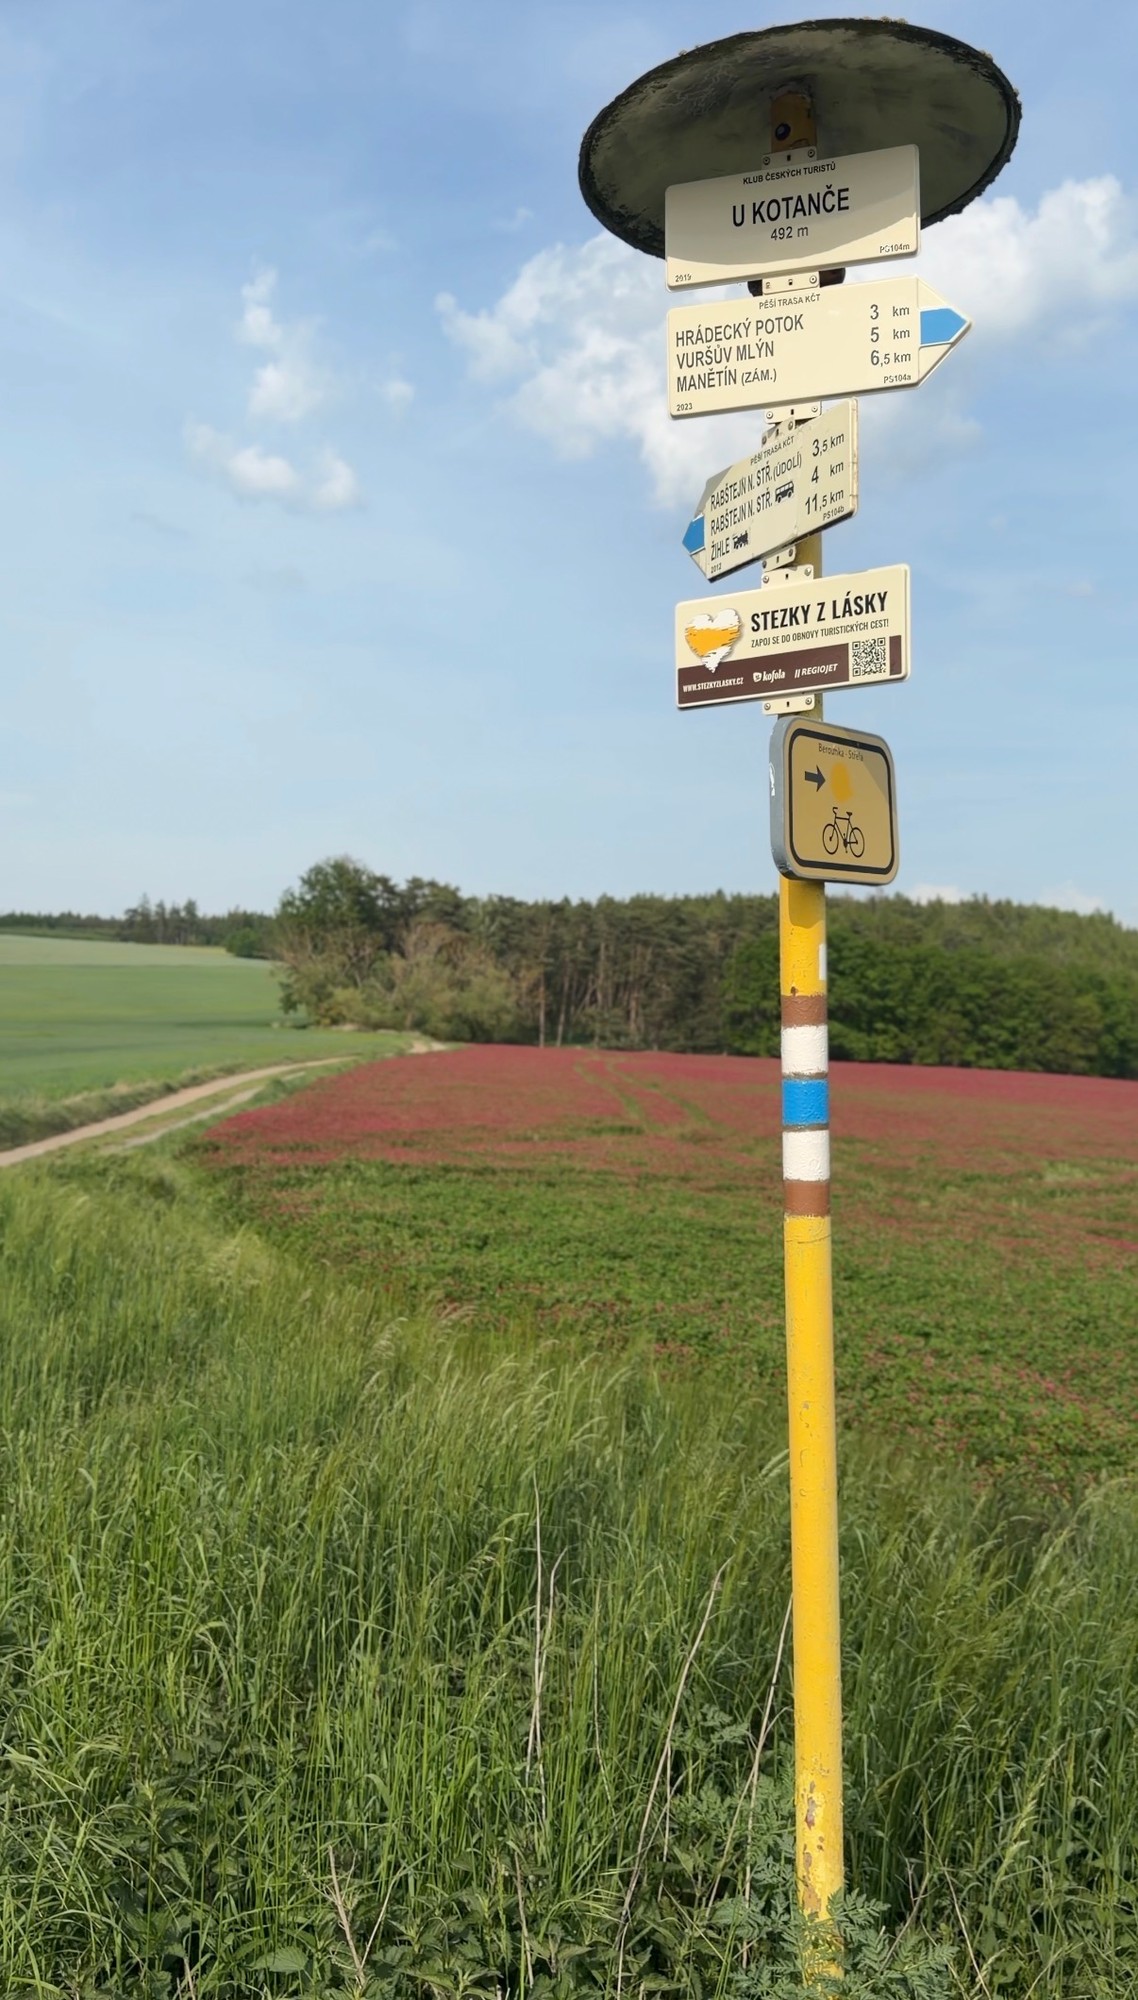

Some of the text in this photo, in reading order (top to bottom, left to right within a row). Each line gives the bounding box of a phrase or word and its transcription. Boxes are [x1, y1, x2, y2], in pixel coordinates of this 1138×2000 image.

[743, 161, 836, 184] KLUB ČESKÝCH TURISTŮ
[732, 184, 850, 227] U KOTANČE
[770, 226, 809, 241] 492 m
[759, 293, 820, 309] PĚŠÍ TRASA KČT
[869, 304, 910, 320] 3 km
[675, 314, 804, 347] HRÁDECKÝ POTOK
[870, 327, 910, 343] 5 km
[676, 338, 774, 370] VURŠŮV MLÝN
[870, 350, 911, 368] 6,5 km
[676, 366, 777, 393] MANĚTÍN (ZÁM.)
[883, 373, 911, 384] PS104a
[676, 402, 693, 412] 2023
[763, 444, 782, 459] TRASA
[782, 436, 795, 449] KČT
[812, 433, 845, 457] 3,5 km
[747, 474, 755, 492] N.
[756, 460, 773, 487] STŘ.
[773, 451, 802, 481] (ÚDOLÍ)
[811, 461, 844, 484] 4 km
[747, 499, 755, 518] N.
[756, 486, 773, 513] STŘ.
[805, 489, 844, 515] 11,5 km
[711, 564, 722, 574] 2012
[751, 591, 888, 632] STEZKY Z LÁSKY
[751, 618, 889, 648] ZAPOJ SE DO OBNOVY TURISTICKÝCH CEST!
[763, 669, 786, 683] kofola
[801, 663, 838, 676] REGIOJET
